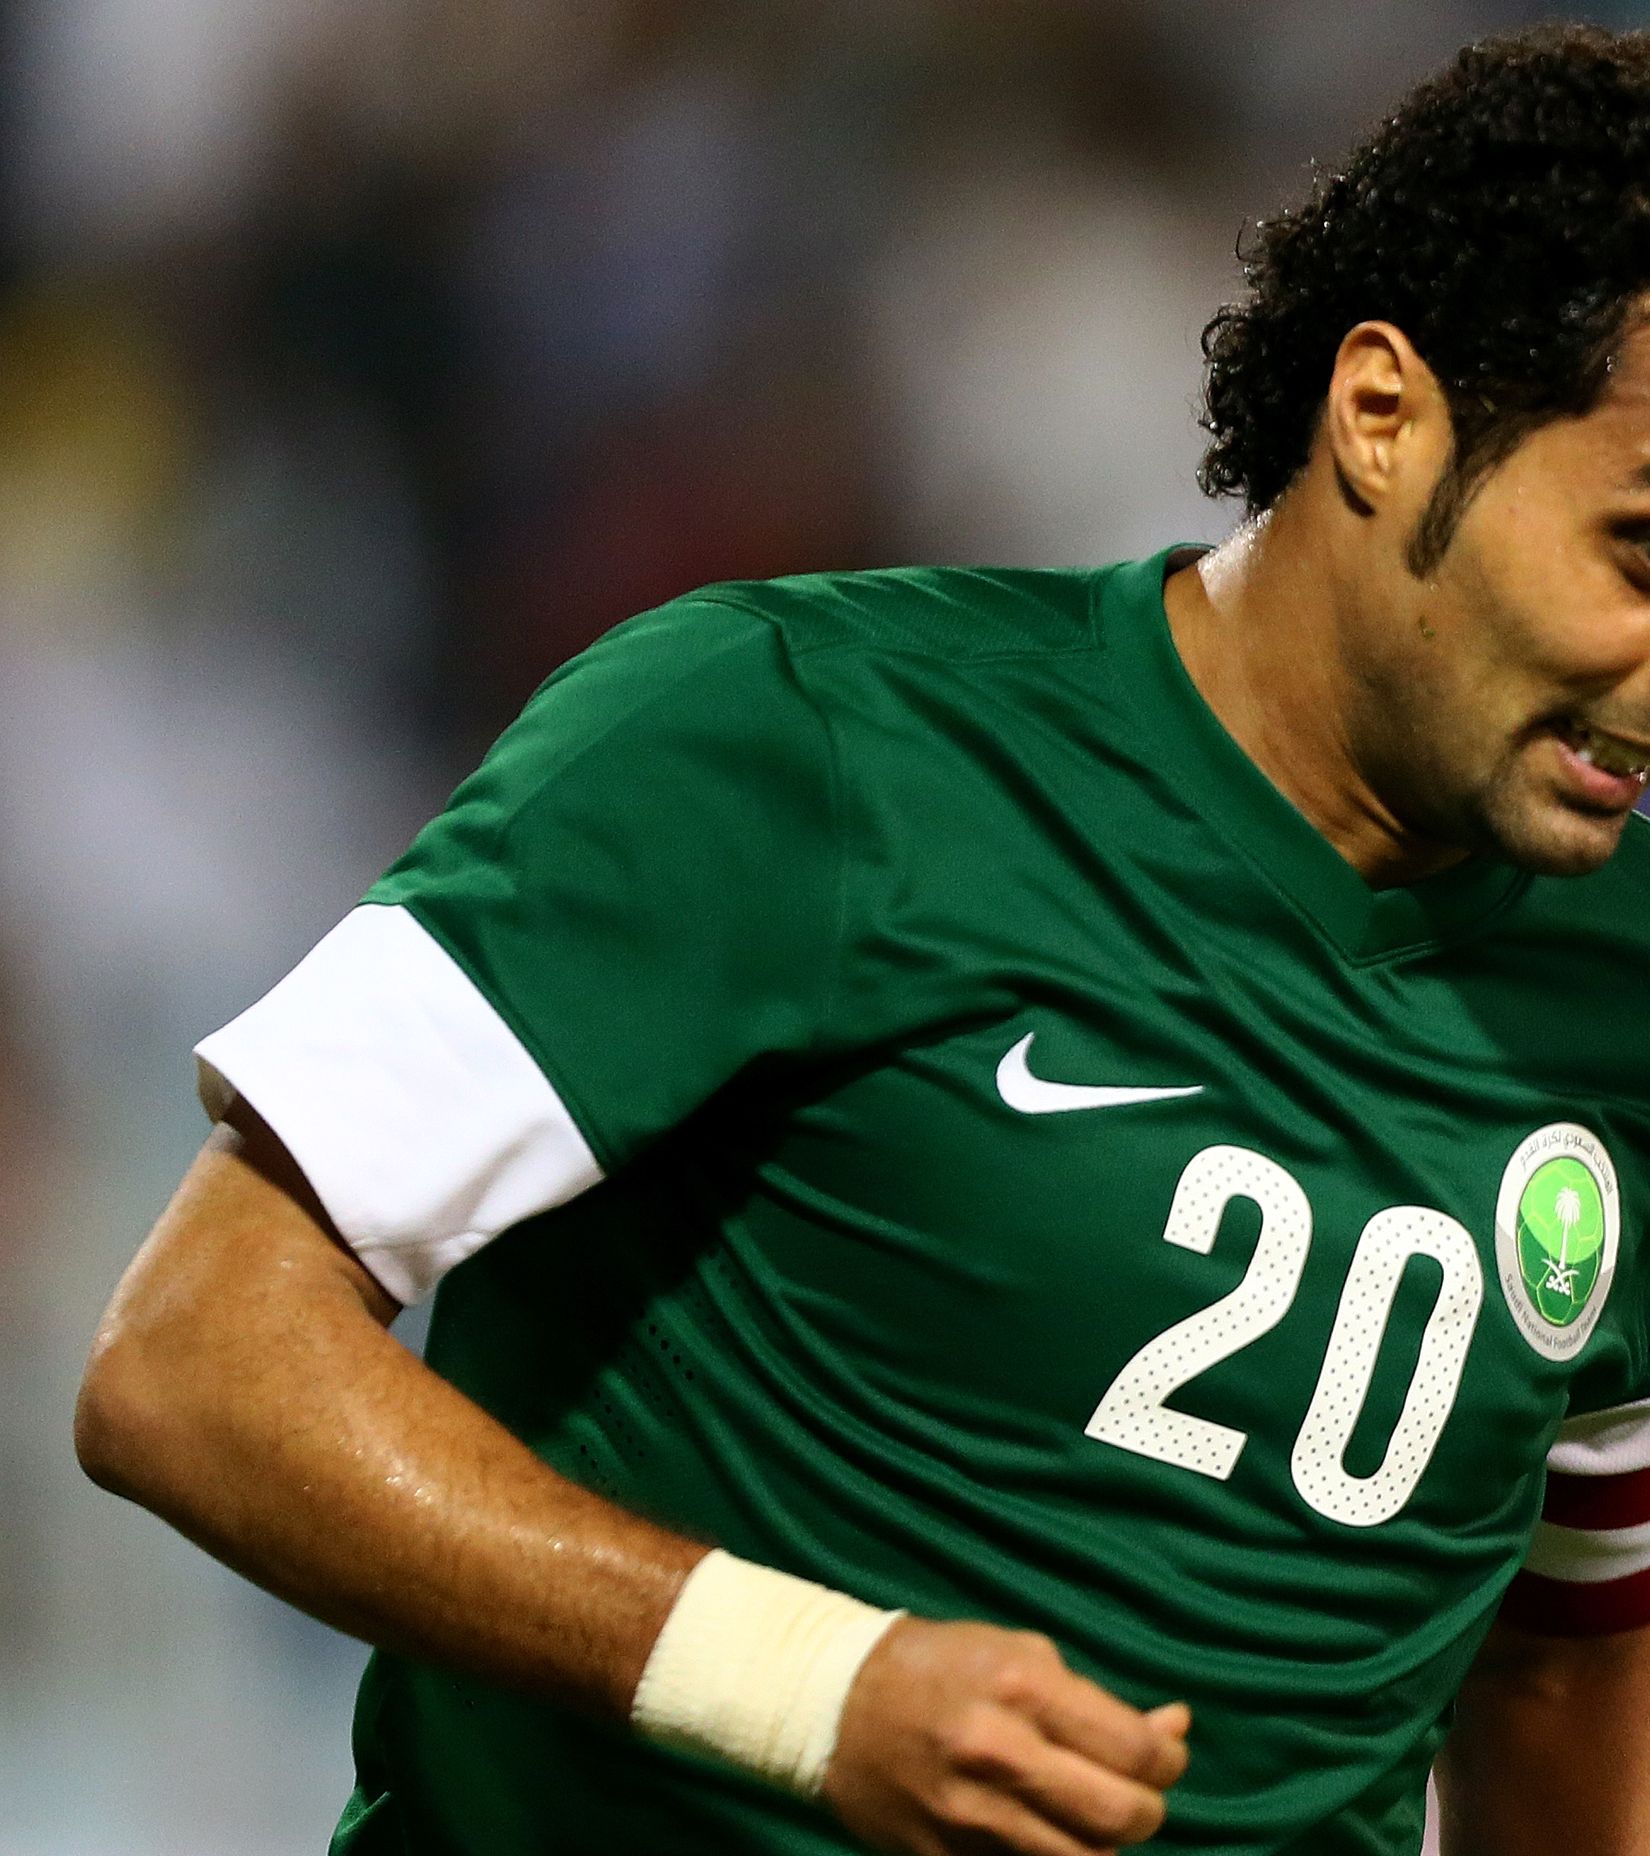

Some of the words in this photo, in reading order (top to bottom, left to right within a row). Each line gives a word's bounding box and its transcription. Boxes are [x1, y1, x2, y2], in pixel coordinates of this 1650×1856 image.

[1084, 1144, 1484, 1527] 20
[1505, 1273, 1523, 1312] Saudi
[1521, 1310, 1552, 1346] National
